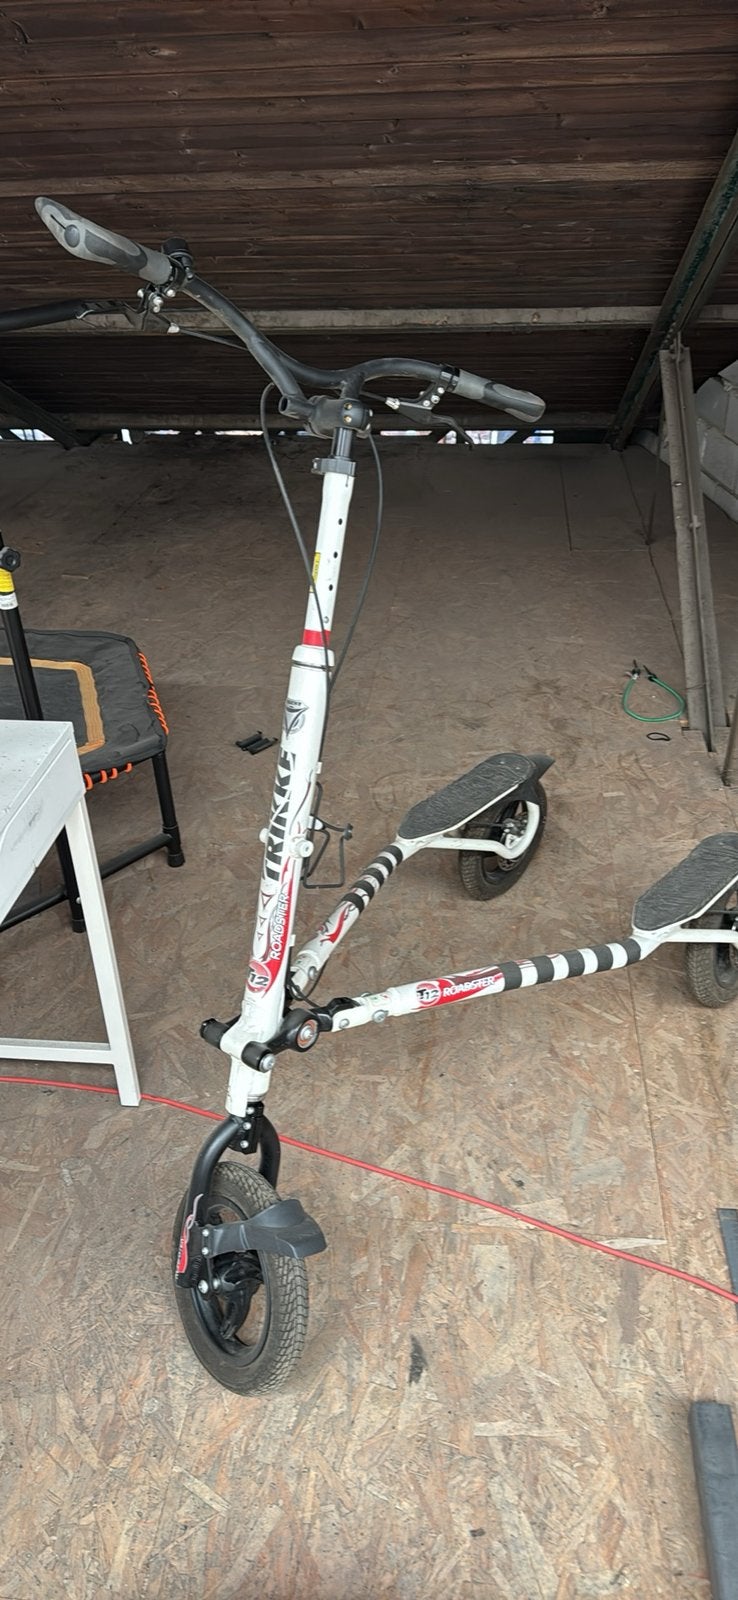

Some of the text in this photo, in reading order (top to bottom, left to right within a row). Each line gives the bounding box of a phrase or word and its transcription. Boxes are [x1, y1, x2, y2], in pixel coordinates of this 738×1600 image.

[264, 750, 296, 882] TRIKKE
[269, 893, 290, 960] ROADSTER
[443, 977, 495, 997] ROADSTER
